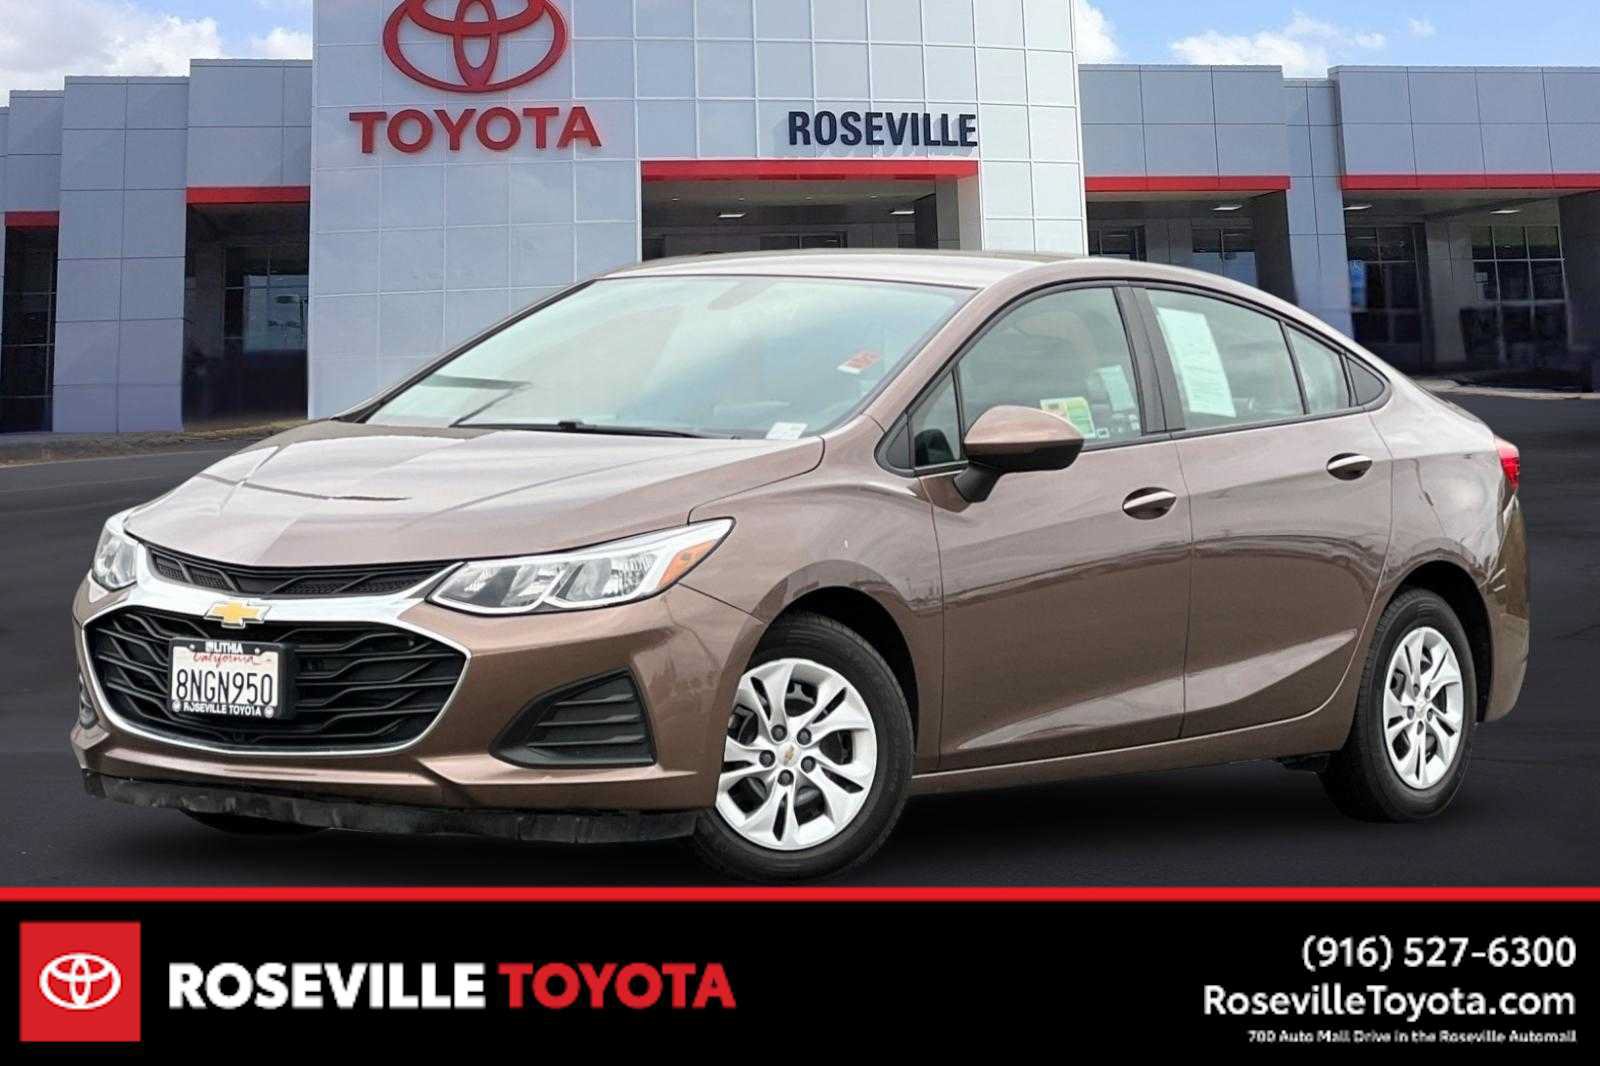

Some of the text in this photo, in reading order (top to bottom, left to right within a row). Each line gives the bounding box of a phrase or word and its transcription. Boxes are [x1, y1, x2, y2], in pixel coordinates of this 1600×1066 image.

[349, 106, 603, 154] TOYOTA
[788, 110, 978, 147] ROSEVILLE
[176, 668, 273, 705] 8NGN950
[183, 702, 262, 716] ROSEVILLE TOYOTA
